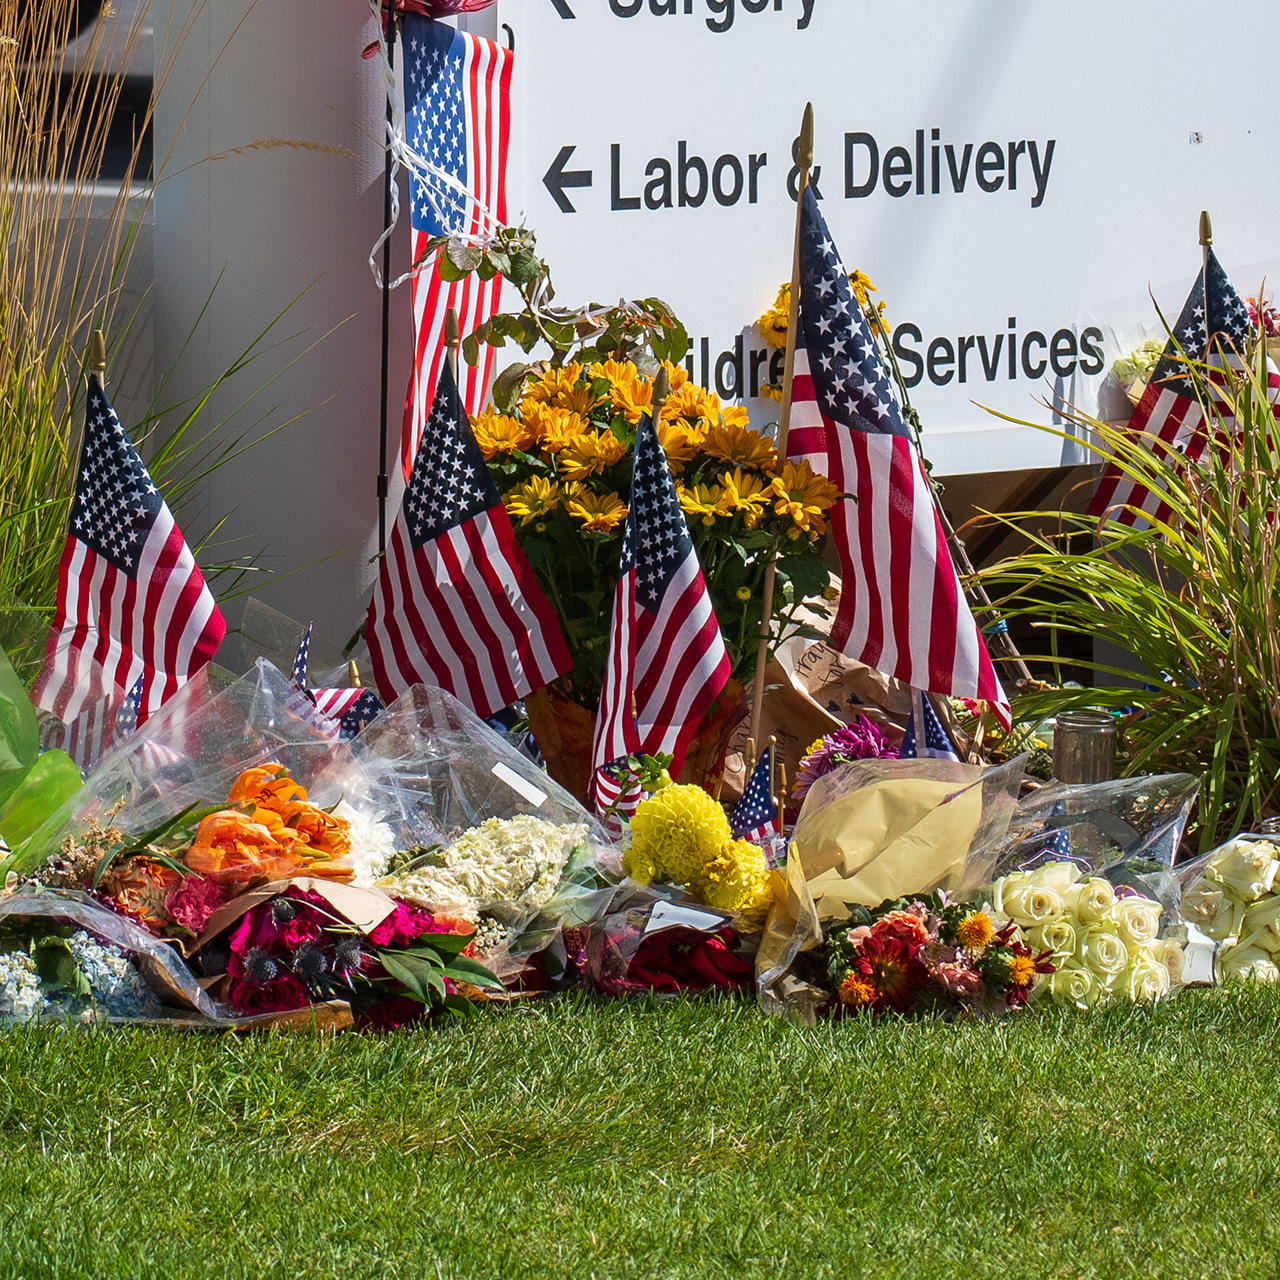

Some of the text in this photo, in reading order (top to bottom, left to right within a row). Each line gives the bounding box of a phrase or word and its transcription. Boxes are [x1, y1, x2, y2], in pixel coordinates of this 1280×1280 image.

[611, 140, 767, 211] Labor
[845, 128, 1056, 209] Delivery
[892, 317, 1105, 389] Services
